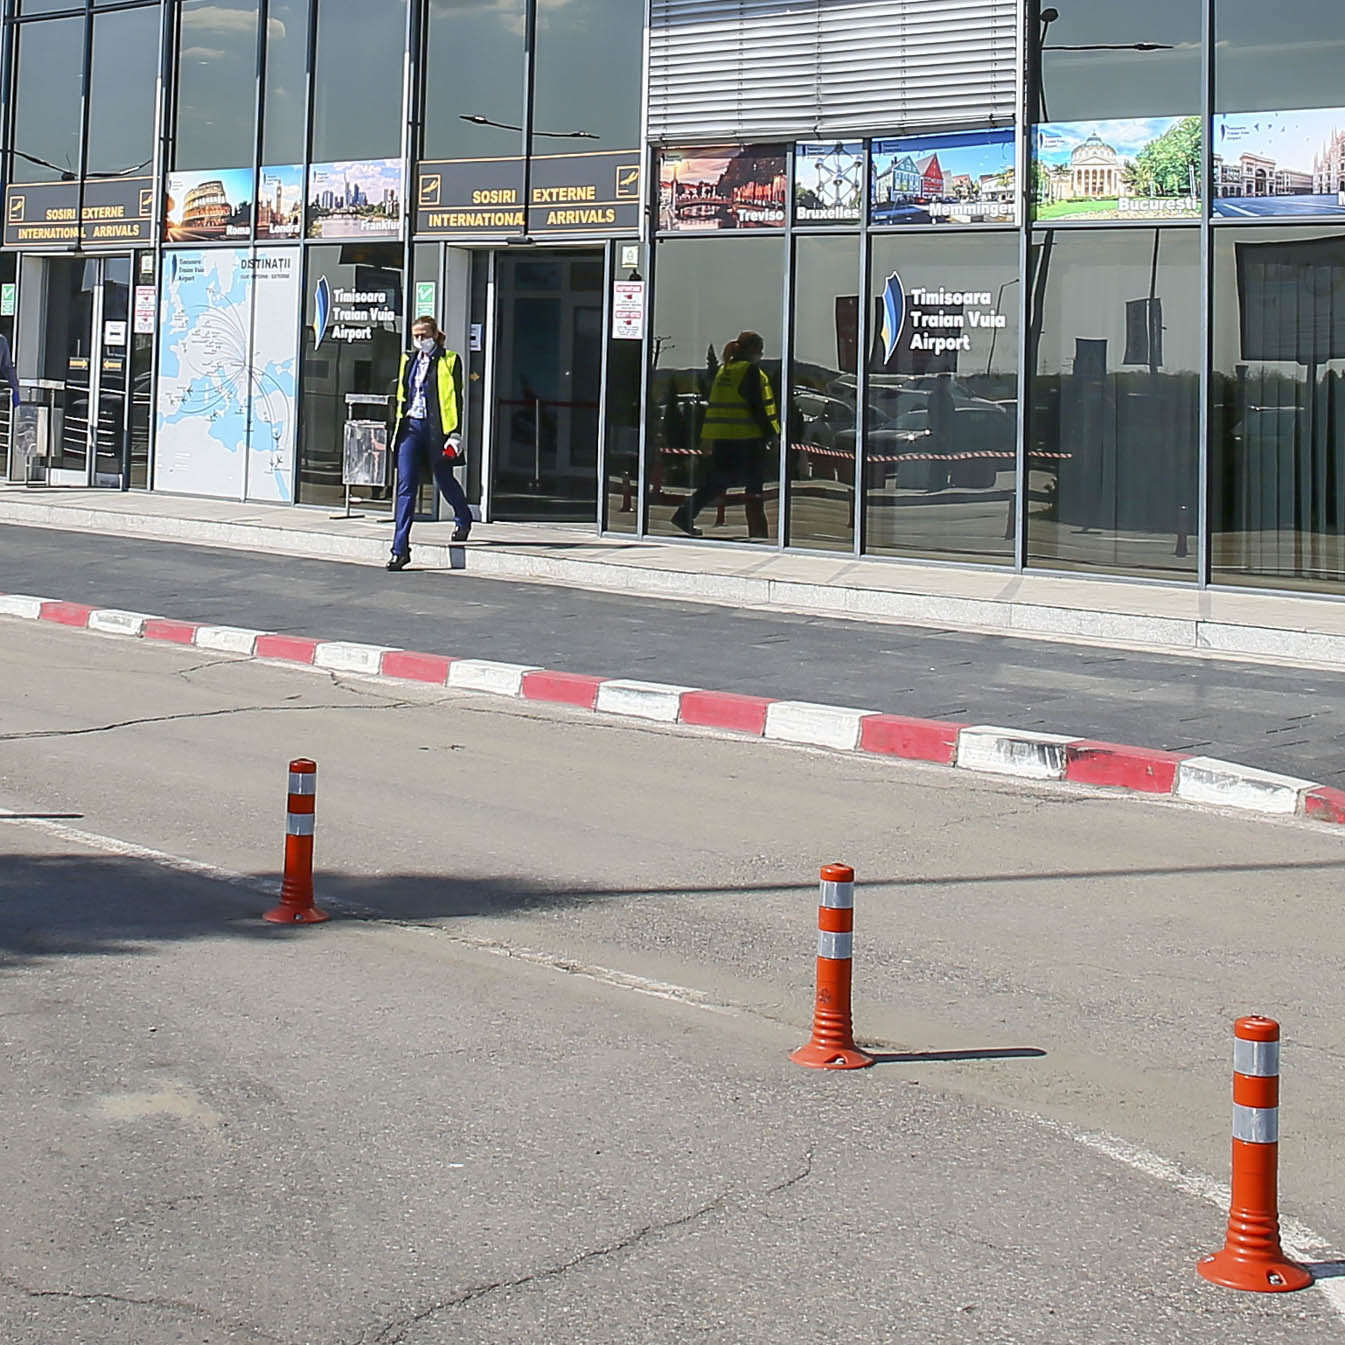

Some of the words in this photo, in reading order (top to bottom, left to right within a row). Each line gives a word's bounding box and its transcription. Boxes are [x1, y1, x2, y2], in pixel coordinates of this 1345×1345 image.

[472, 189, 517, 204] SOSIRI
[532, 186, 596, 203] EXTERNE
[46, 208, 76, 221] SOSIRI
[81, 205, 125, 219] EXTERNE
[546, 208, 616, 225] ARRIVALS
[738, 207, 785, 222] Treviso
[796, 206, 860, 220] Bruxelles
[929, 201, 1016, 219] Memmingen
[92, 224, 140, 238] ARRIVALS
[226, 224, 250, 236] Roma
[269, 221, 301, 234] Londra
[360, 218, 402, 232] Frankfur
[332, 288, 387, 304] Timisoara
[910, 287, 992, 306] Timisoara
[332, 307, 366, 322] Traian
[369, 307, 396, 322] Vuia
[910, 310, 965, 329] Traian
[967, 310, 1007, 329] Vuia
[331, 325, 373, 343] Airport
[909, 333, 971, 356] Airport
